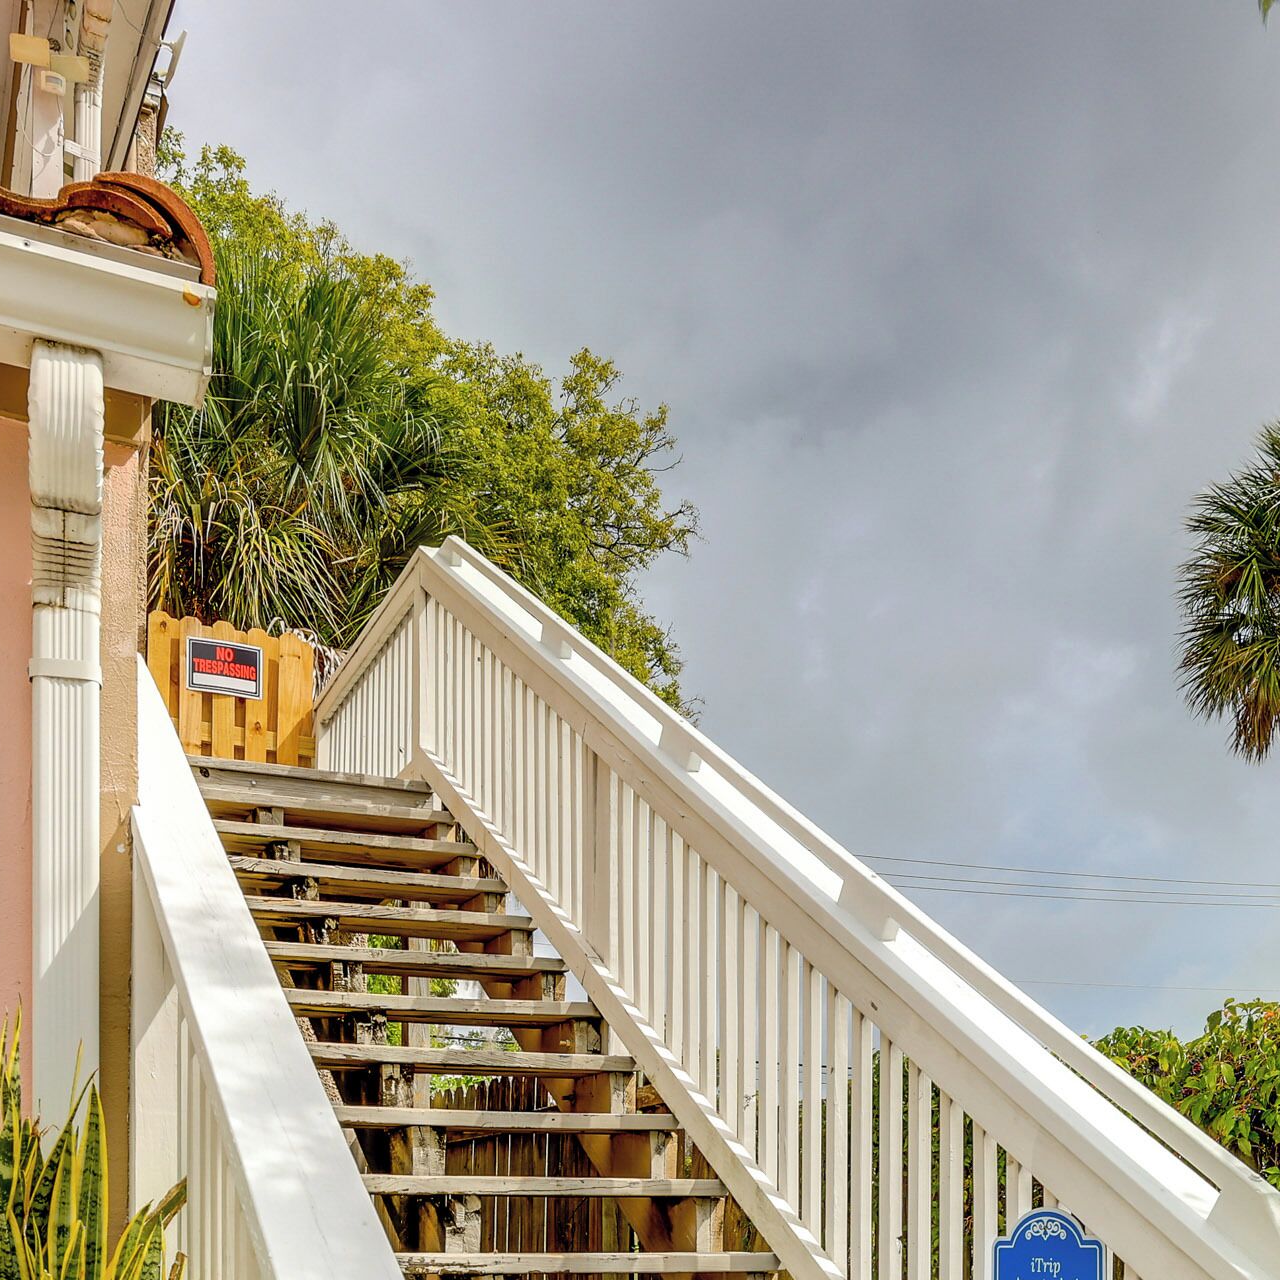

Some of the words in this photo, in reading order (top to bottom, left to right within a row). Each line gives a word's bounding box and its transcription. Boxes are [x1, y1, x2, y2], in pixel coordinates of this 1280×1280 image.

[216, 647, 234, 661] NO
[193, 658, 256, 680] TRESPASSING
[1031, 1257, 1061, 1277] iTrip
